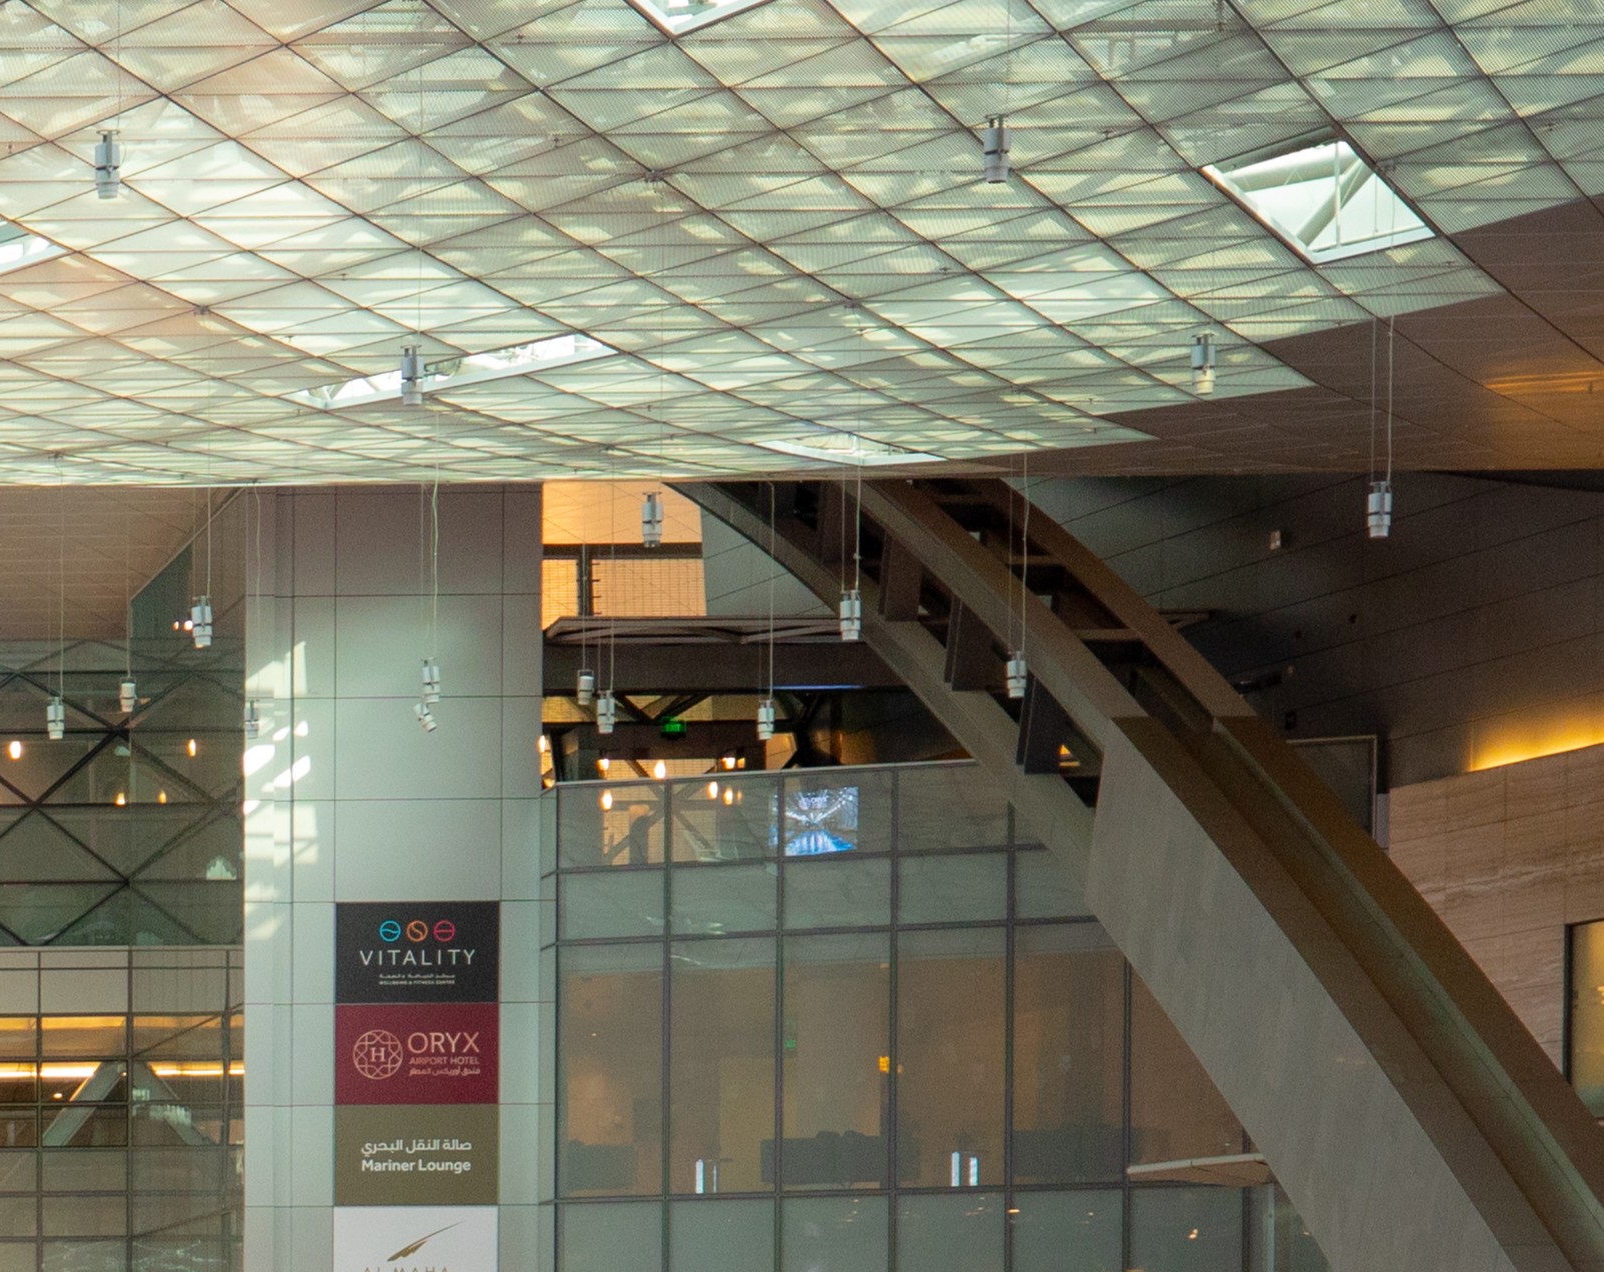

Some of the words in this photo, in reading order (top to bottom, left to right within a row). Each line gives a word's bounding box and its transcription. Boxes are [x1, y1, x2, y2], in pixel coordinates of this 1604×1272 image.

[359, 949, 476, 966] VITALITY
[407, 1031, 480, 1054] ORYX
[409, 1056, 448, 1065] AIRPORT
[450, 1056, 480, 1065] HOTEL
[360, 1139, 404, 1158] البحري
[405, 1138, 441, 1154] النقل
[442, 1139, 473, 1151] صالة
[361, 1159, 416, 1172] Mariner
[418, 1159, 472, 1174] Lounge
